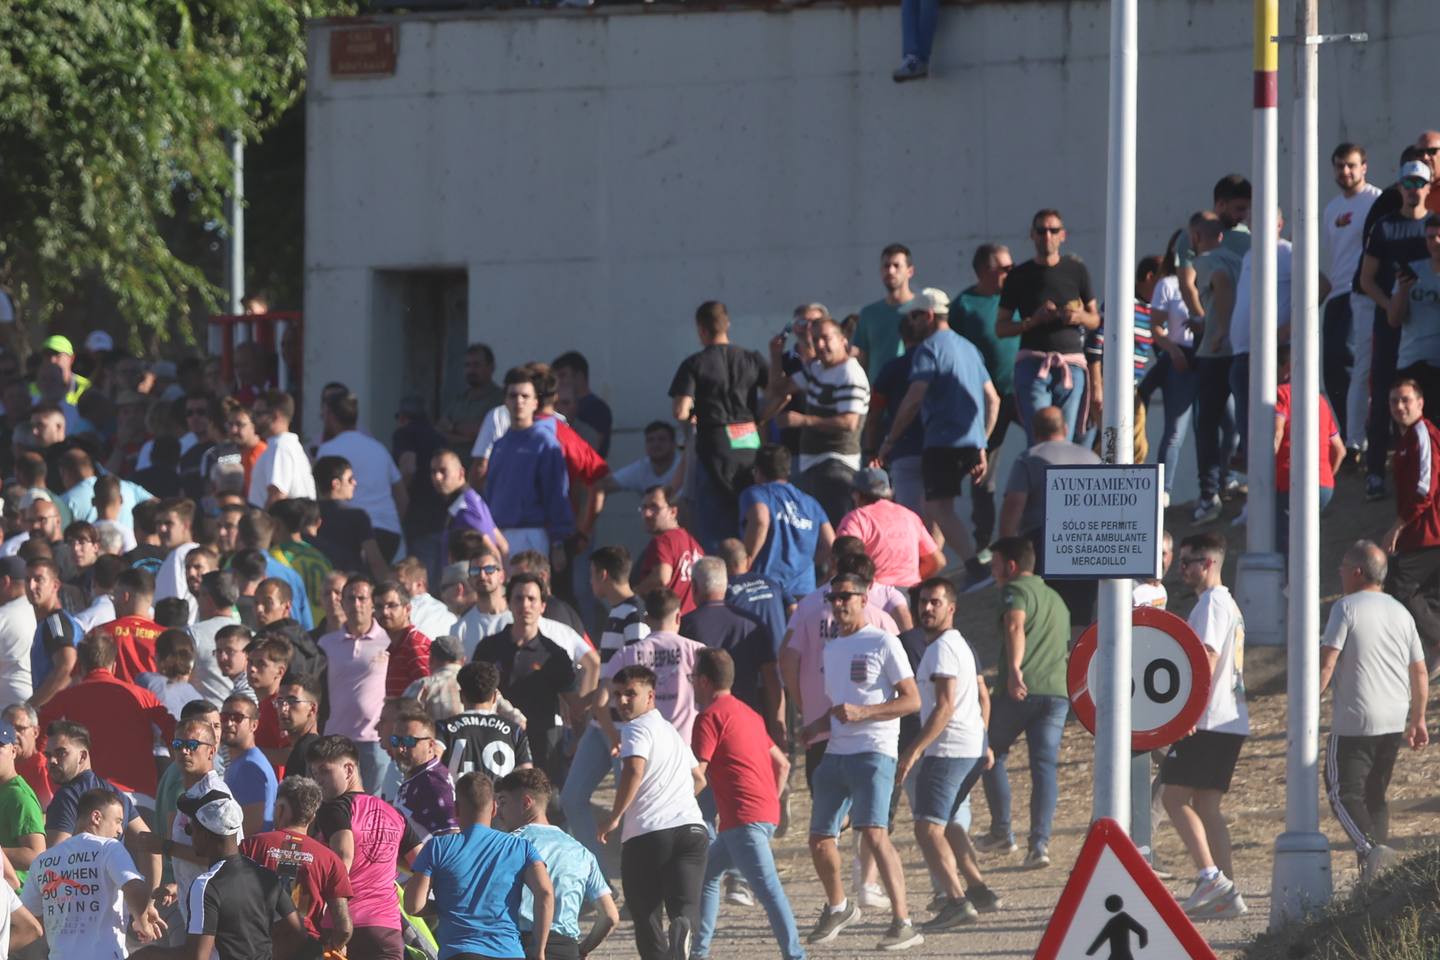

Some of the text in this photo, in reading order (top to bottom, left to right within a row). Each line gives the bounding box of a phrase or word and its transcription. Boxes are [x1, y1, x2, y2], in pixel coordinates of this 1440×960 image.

[1051, 477, 1151, 491] AYUNTAMIENTO
[1064, 493, 1137, 507] DE OLMEDO
[1088, 521, 1098, 530] SE
[1101, 521, 1138, 530] PERMITE
[1052, 533, 1147, 542] LA VENTA AMBULANTE
[1056, 545, 1073, 554] LOS
[1119, 545, 1130, 554] EN
[1132, 545, 1142, 554] EL
[1071, 556, 1126, 566] MERCADILLO
[1131, 658, 1180, 704] 0
[447, 716, 511, 735] GARNACHO
[39, 851, 99, 868] YOU ONLY
[37, 868, 98, 884] FAIL WHEN
[43, 888, 57, 900] OU
[64, 884, 100, 896] STOP
[48, 900, 100, 916] RYING
